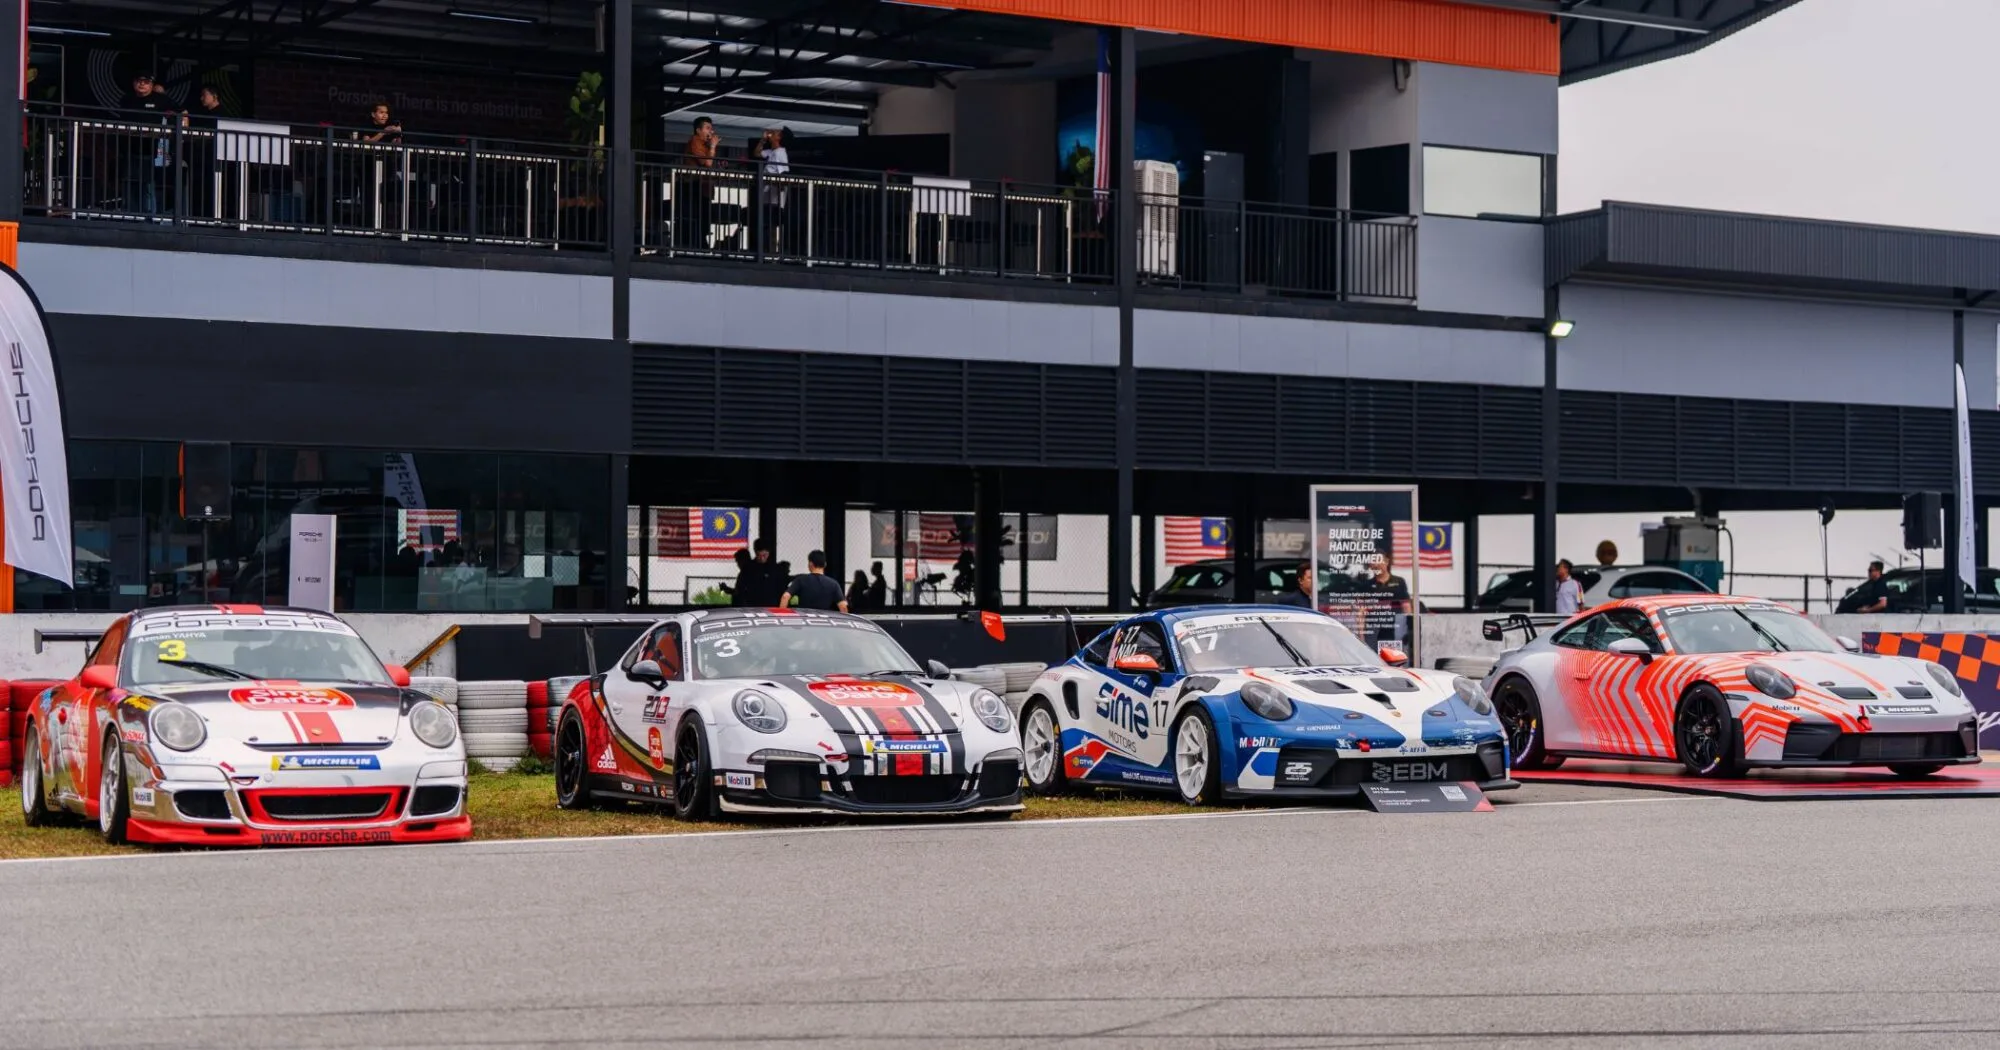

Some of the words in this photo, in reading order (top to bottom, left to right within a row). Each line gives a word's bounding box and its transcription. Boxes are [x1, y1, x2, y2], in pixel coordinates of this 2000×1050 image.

[393, 92, 432, 110] There
[436, 95, 448, 112] is
[452, 99, 469, 114] no
[1329, 528, 1355, 539] BUILT
[1357, 528, 1369, 539] TO
[1371, 528, 1384, 539] BE
[1329, 541, 1376, 552] HANDLED,
[1329, 554, 1349, 564] NOT
[1351, 554, 1384, 564] TAMED.
[144, 619, 347, 632] PORSCHE
[700, 618, 878, 633] PORSCHE
[1124, 626, 1141, 643] 17
[714, 638, 741, 658] 3
[1181, 632, 1218, 654] 17
[159, 640, 187, 661] 3
[250, 688, 328, 697] Sime
[825, 684, 894, 693] Sime
[249, 696, 339, 707] Darby
[827, 690, 908, 703] Darby
[1153, 700, 1170, 728] 17
[1108, 730, 1137, 753] MOTORS
[1239, 736, 1265, 748] Mobil
[597, 761, 617, 770] adidas
[1393, 762, 1448, 780] EBM
[728, 775, 744, 786] Mobil
[261, 829, 391, 844] www.porsche.com
